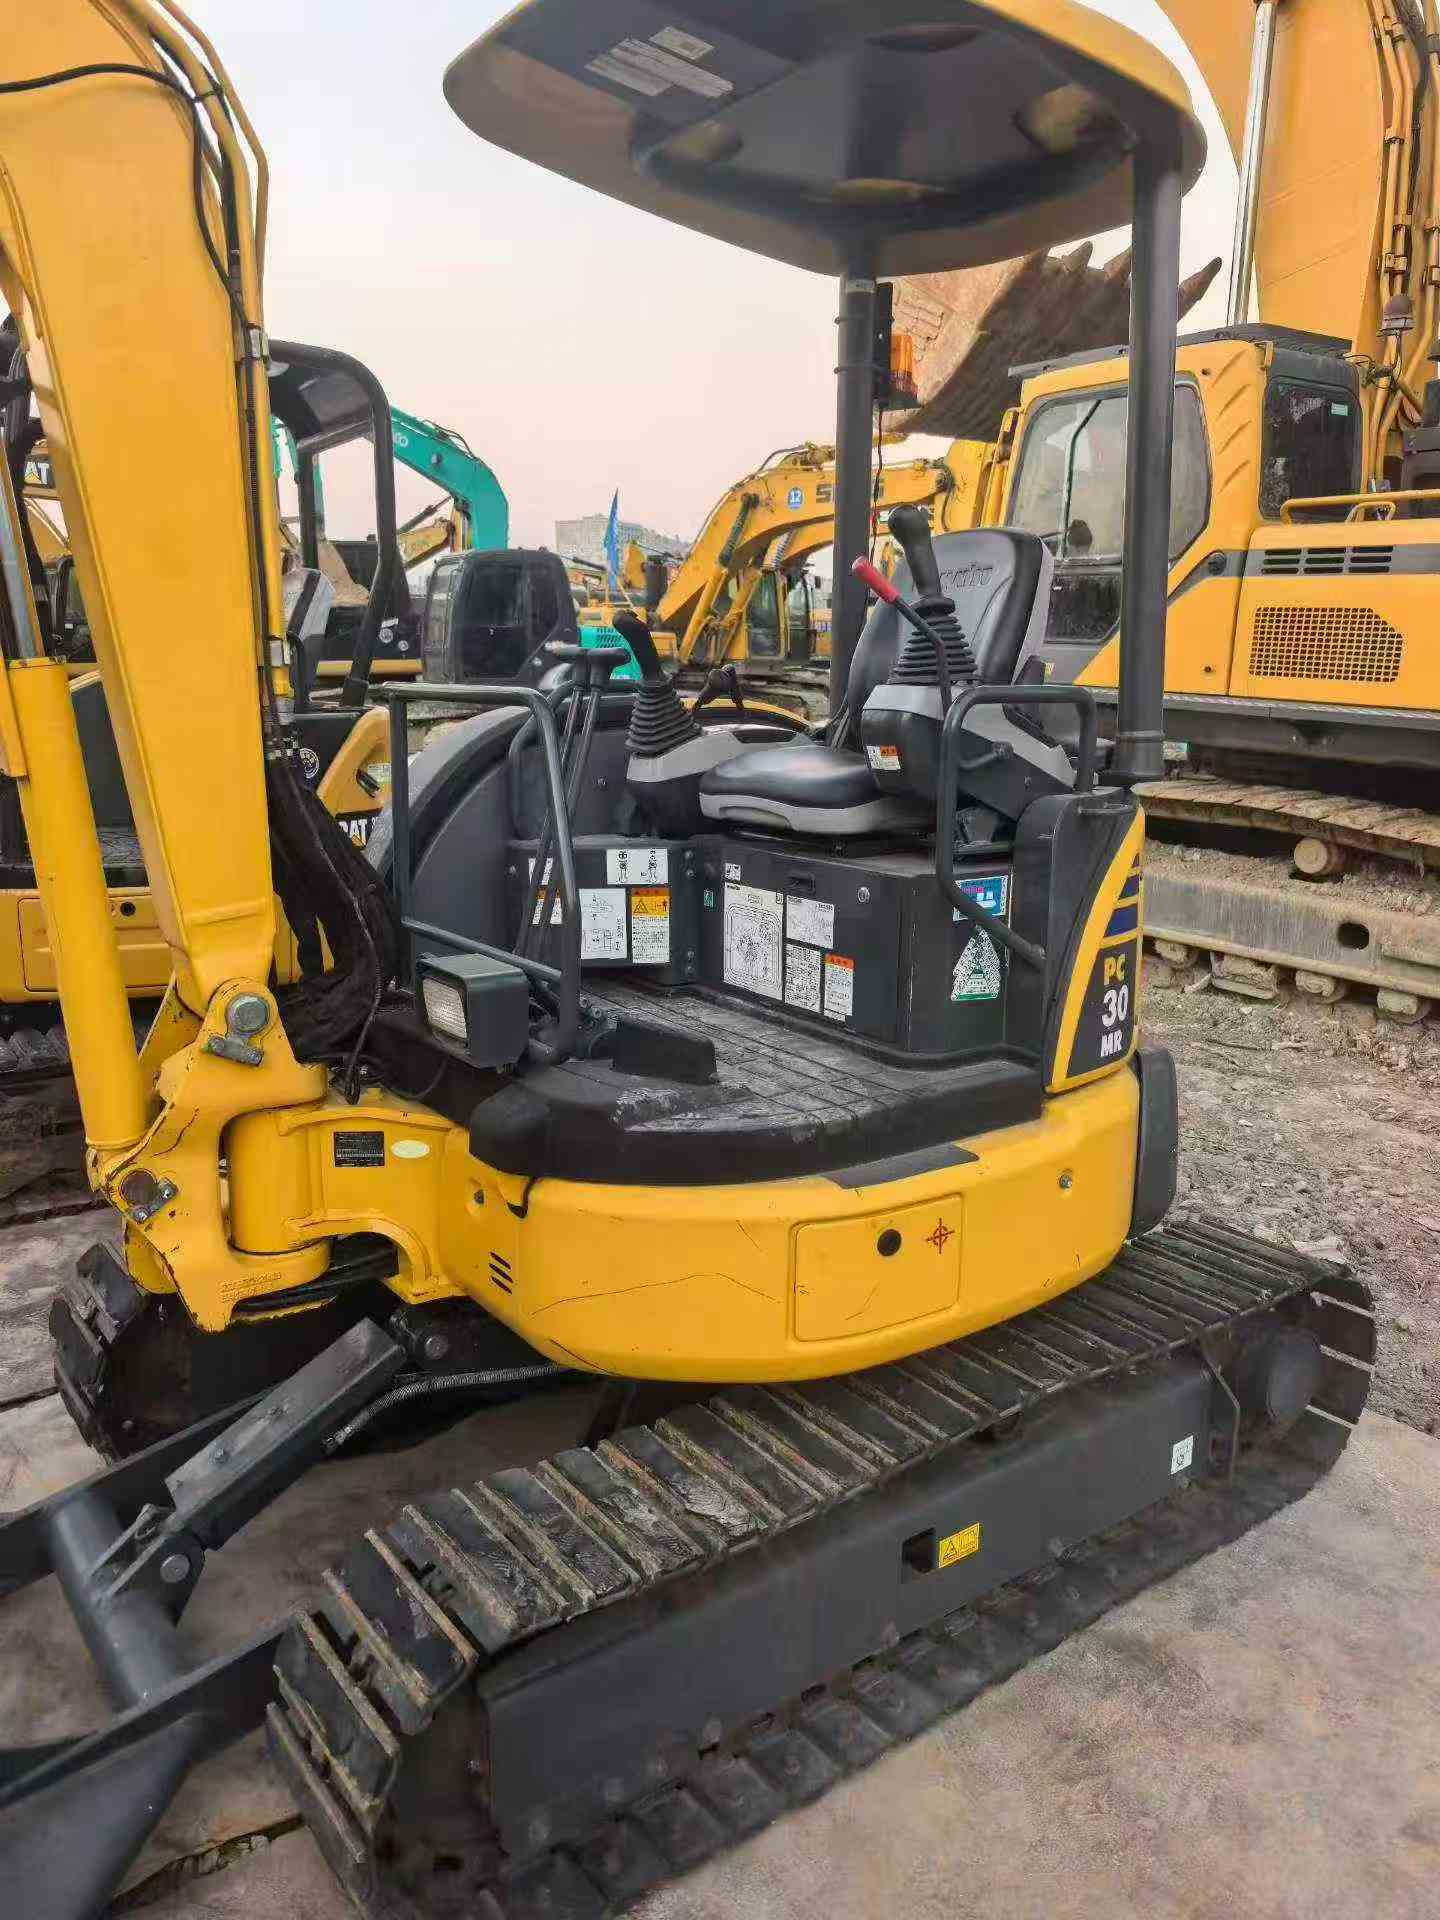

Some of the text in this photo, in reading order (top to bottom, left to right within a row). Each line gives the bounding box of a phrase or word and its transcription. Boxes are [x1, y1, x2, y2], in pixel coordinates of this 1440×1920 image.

[1104, 954, 1126, 986] PC
[1102, 985, 1128, 1027] 30
[1101, 1030, 1122, 1057] MR
